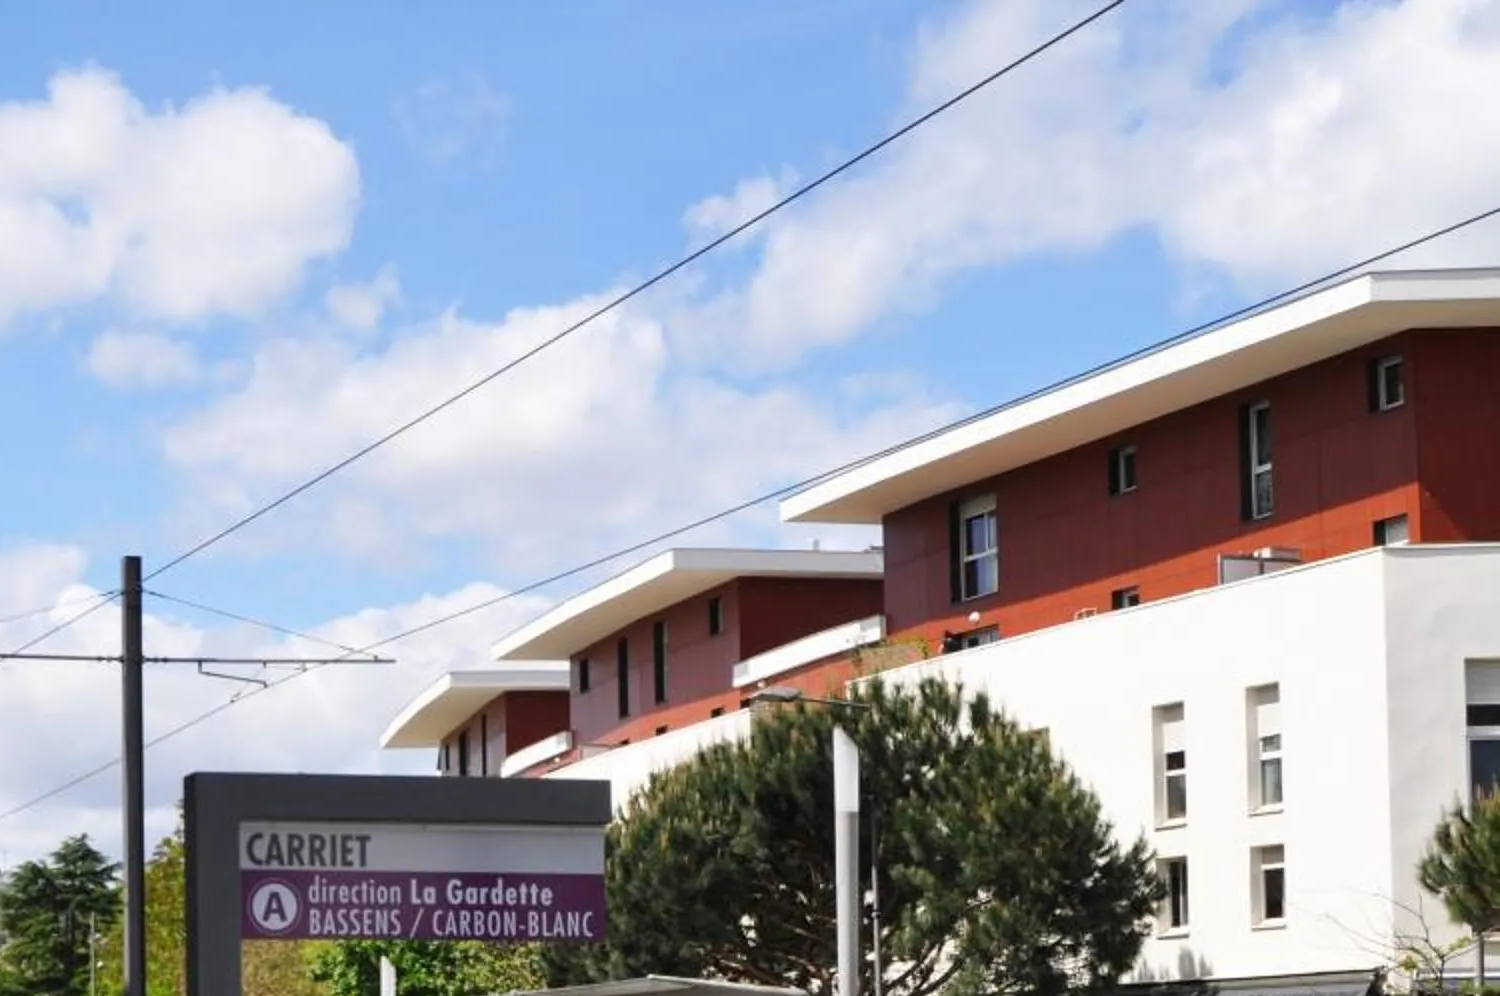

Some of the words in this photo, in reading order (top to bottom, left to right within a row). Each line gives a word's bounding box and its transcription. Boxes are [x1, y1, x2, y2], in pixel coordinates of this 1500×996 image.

[246, 832, 372, 867] CARRIET
[308, 875, 402, 905] direction
[410, 877, 436, 905] La
[446, 877, 554, 906] Gardette
[263, 891, 289, 923] A
[308, 908, 402, 936] BASSENS
[409, 908, 425, 939] /
[432, 909, 594, 938] CARBON-BLANC
